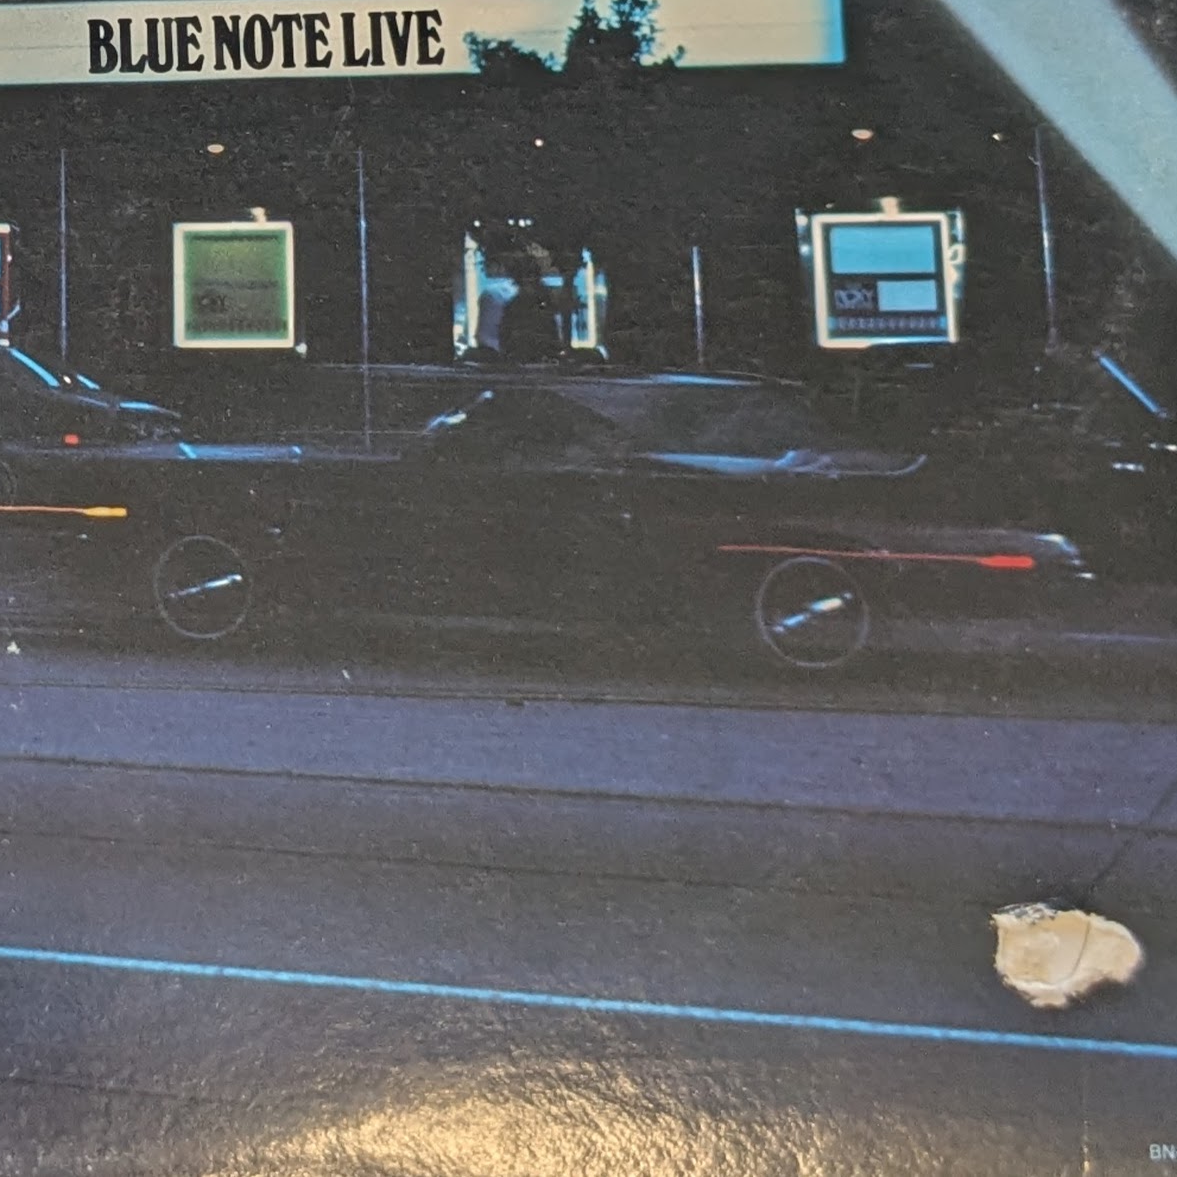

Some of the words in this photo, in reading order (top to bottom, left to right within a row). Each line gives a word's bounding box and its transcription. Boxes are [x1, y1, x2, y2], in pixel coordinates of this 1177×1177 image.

[87, 15, 205, 74] BLUE
[211, 12, 333, 71] NOTE
[340, 9, 445, 68] LIVE
[1149, 1143, 1177, 1160] BN
